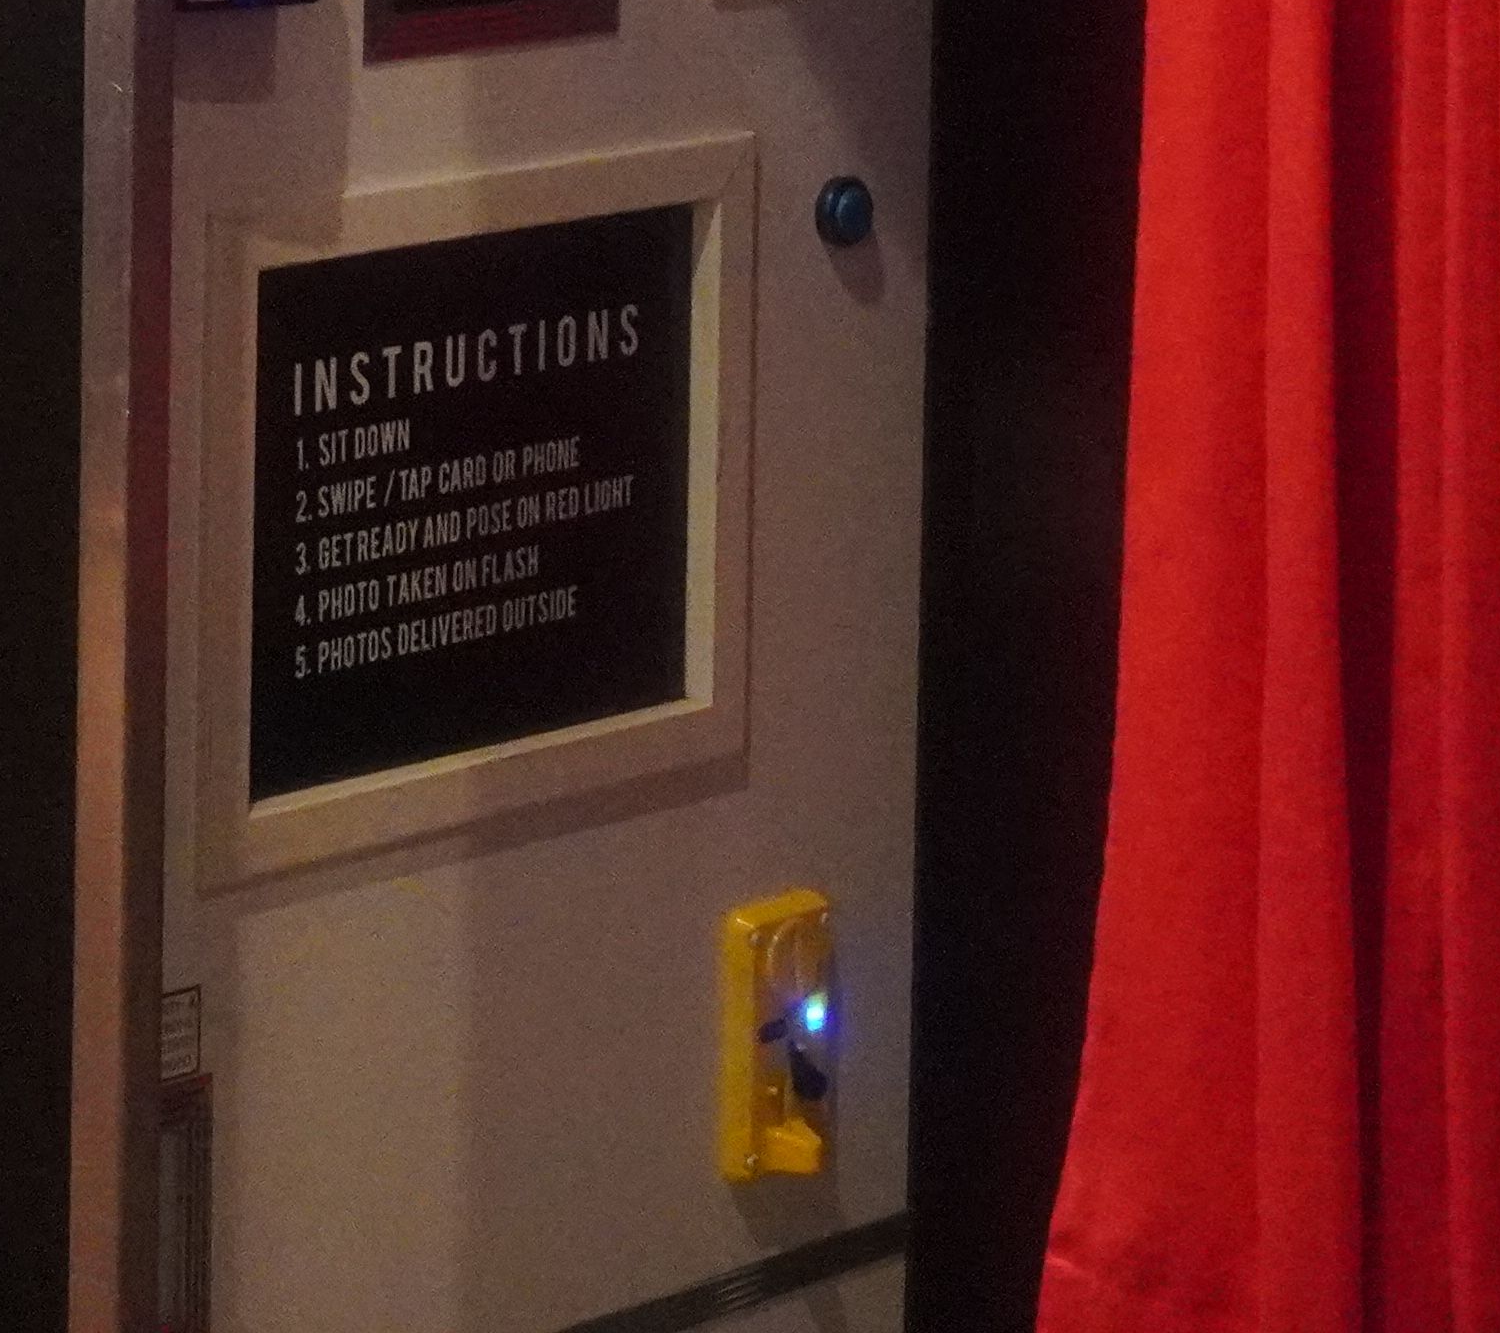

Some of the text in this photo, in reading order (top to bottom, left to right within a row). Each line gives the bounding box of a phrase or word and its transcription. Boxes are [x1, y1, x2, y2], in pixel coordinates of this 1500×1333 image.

[293, 303, 640, 417] INSTRUCTIONS
[295, 489, 313, 523] 2.
[317, 474, 377, 519] SWIPE
[397, 464, 432, 501] TAP
[438, 454, 487, 495] CARD
[493, 450, 517, 483] OR
[522, 436, 581, 478] PHONE
[296, 418, 411, 472] 1. SIT DOWN
[295, 473, 634, 575] 3. GET READY AND POSE ON RED LIGHT
[294, 544, 539, 627] 4. PHOTO TAKEN ON FLASH
[294, 586, 578, 680] 5. PHOTOS DELIVERED OUTSIDE
